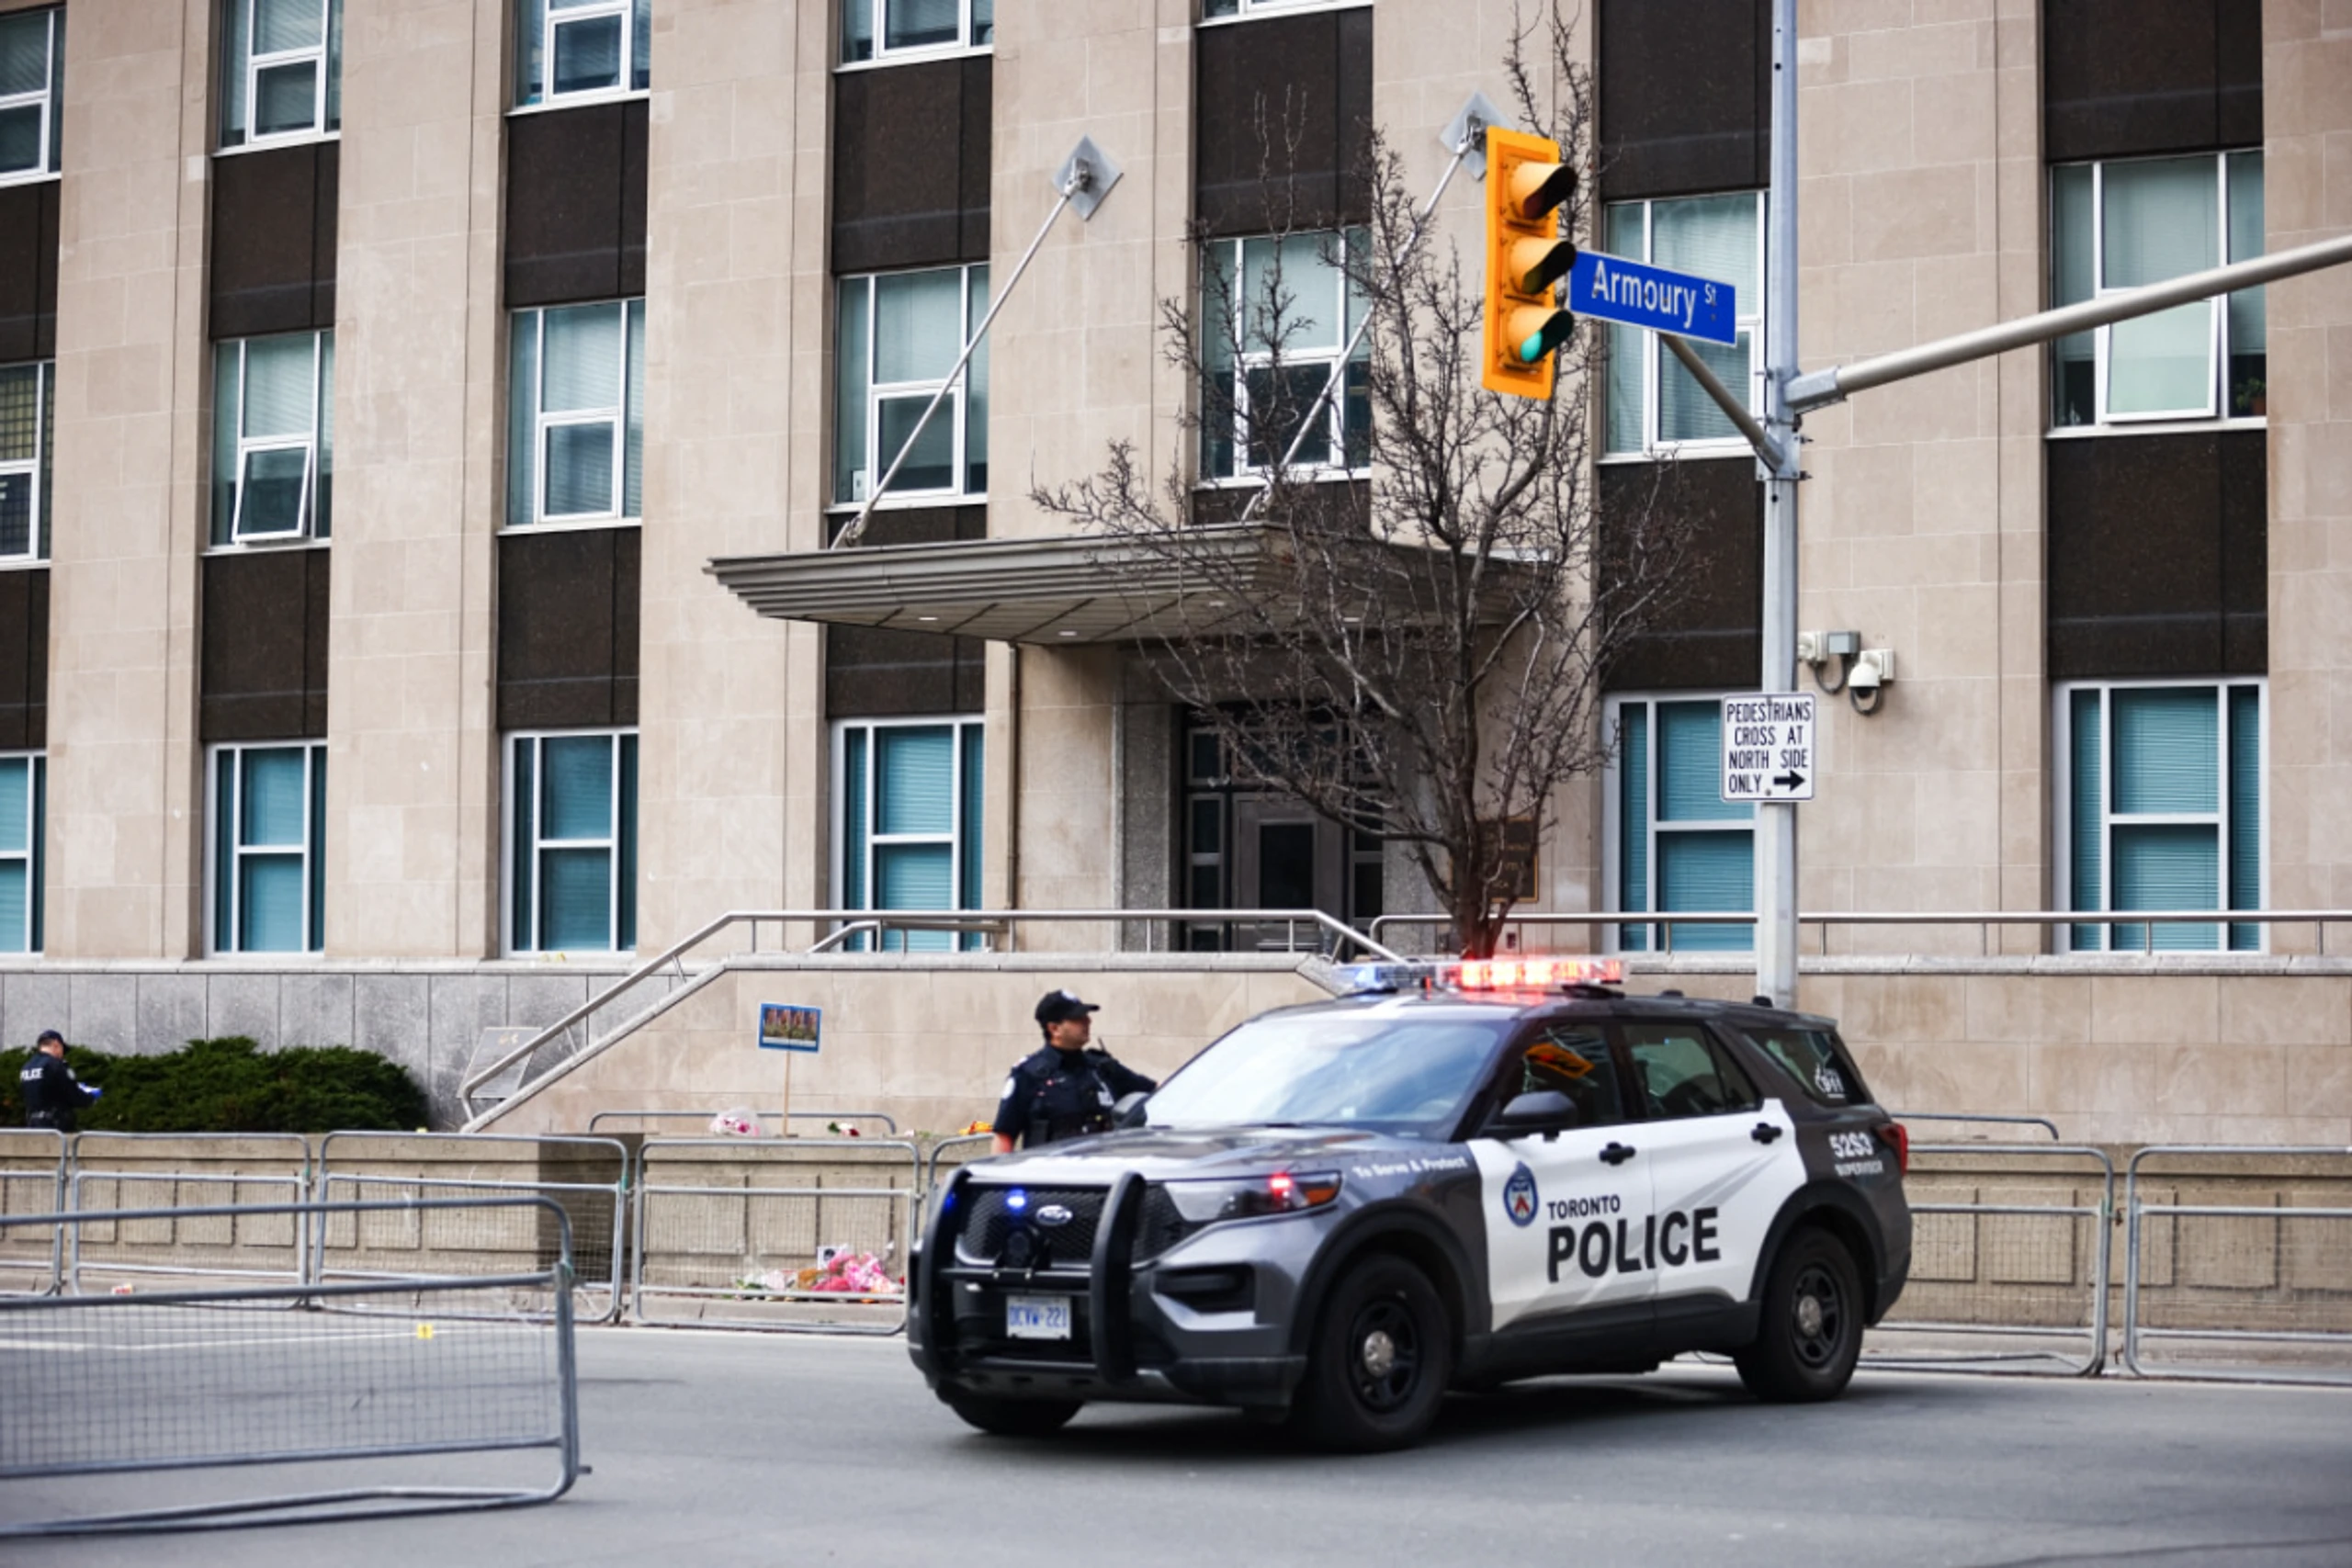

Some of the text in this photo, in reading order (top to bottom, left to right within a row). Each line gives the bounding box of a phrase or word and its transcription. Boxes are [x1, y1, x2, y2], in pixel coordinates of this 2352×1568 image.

[1591, 259, 1717, 329] Armoury St
[1726, 702, 1811, 723] PEDESTRIANS
[1735, 726, 1804, 746] CROSS AT
[1728, 749, 1809, 770] NORTH SIDE
[1728, 773, 1762, 794] ONLY
[1547, 1194, 1621, 1220] TORONTO
[1547, 1207, 1721, 1282] POLICE
